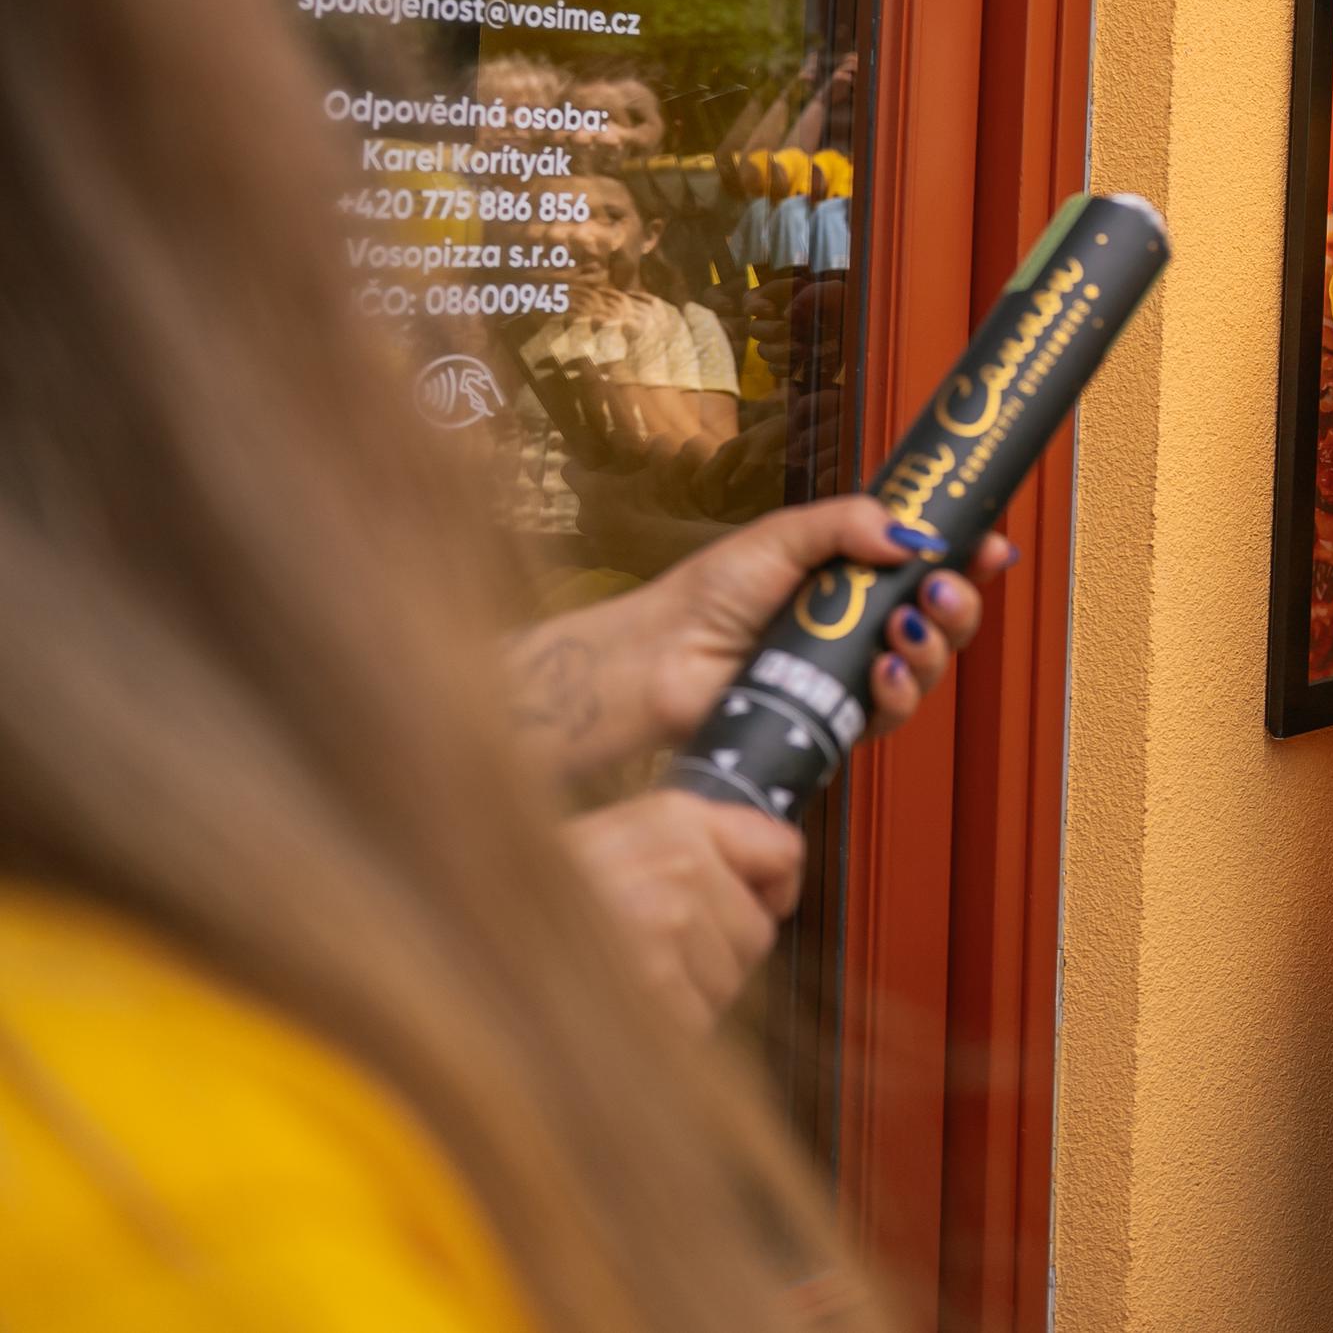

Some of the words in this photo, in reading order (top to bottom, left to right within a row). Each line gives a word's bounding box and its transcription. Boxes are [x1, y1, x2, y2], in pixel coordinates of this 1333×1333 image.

[324, 90, 506, 130] Odpovědná
[513, 101, 609, 132] osoba:
[362, 139, 444, 172] Karel
[337, 188, 413, 220] +420
[420, 190, 472, 221] 775
[479, 190, 532, 222] 886
[538, 192, 590, 223] 856
[347, 238, 501, 274] Vosopizza
[508, 244, 576, 268] s.r.o.
[425, 283, 570, 316] 08600945
